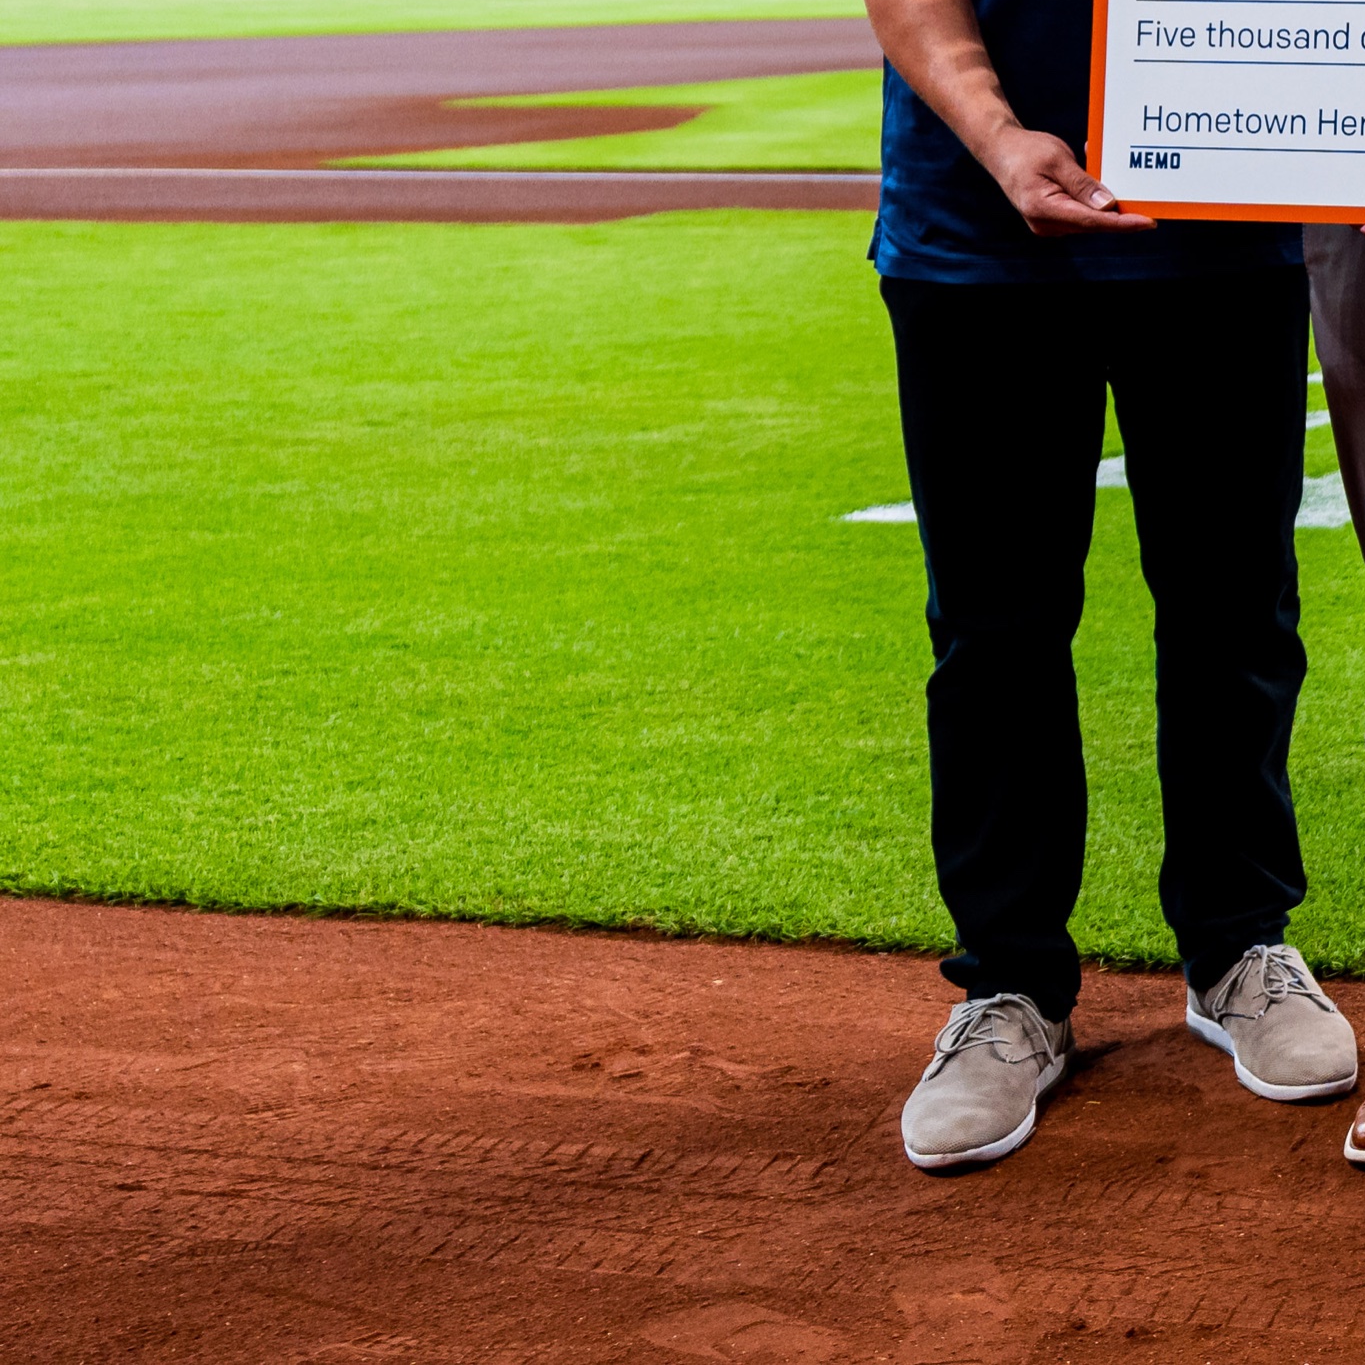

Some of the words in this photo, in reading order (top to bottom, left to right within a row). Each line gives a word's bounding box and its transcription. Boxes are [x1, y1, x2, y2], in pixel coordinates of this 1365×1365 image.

[1136, 21, 1196, 48] Five
[1206, 22, 1350, 51] thousand
[1143, 105, 1306, 135] Hometown
[1130, 152, 1180, 169] MEMO
